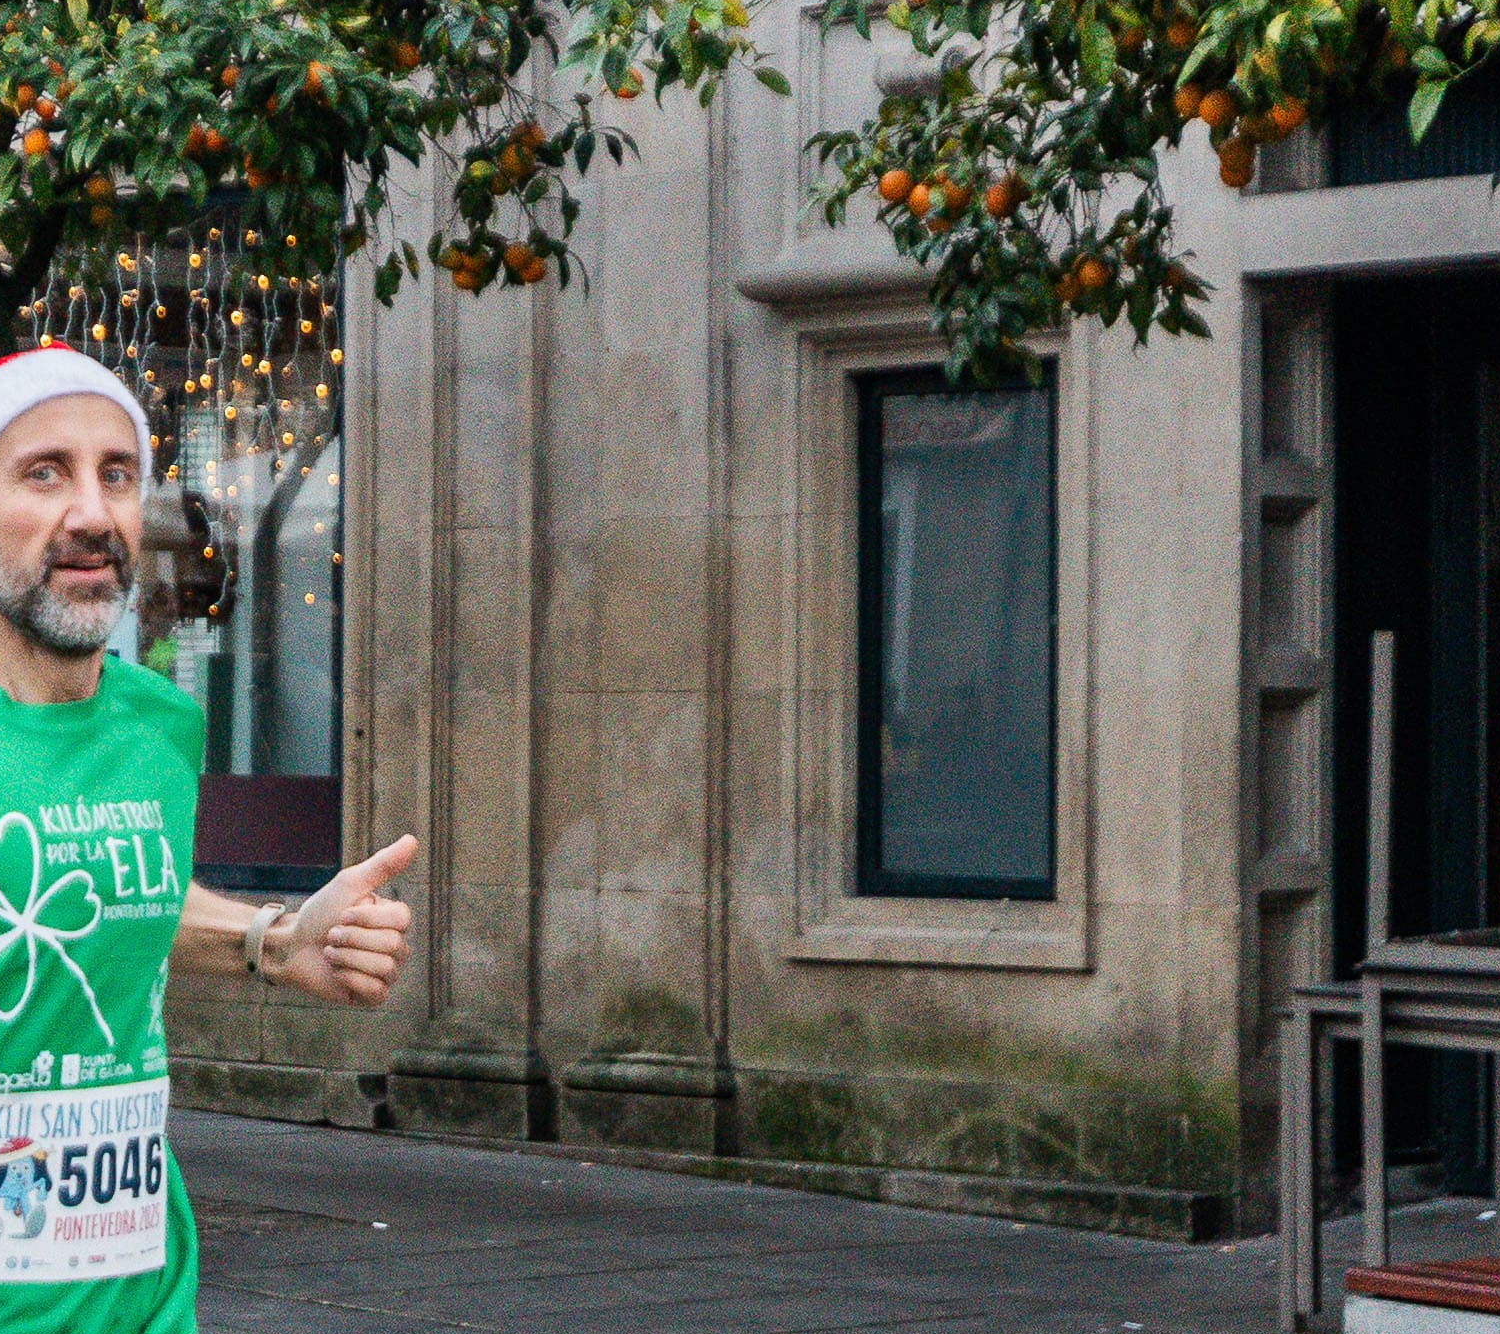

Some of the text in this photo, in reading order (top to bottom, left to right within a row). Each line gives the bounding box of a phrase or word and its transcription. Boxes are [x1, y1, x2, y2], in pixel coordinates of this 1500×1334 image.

[38, 795, 164, 834] KILÓMETROS
[45, 834, 180, 898] POR LA ELA
[39, 1101, 83, 1139] SAN
[89, 1089, 165, 1137] SILVESTRE
[58, 1133, 163, 1207] 5046
[53, 1208, 137, 1242] PONTEVEDRA
